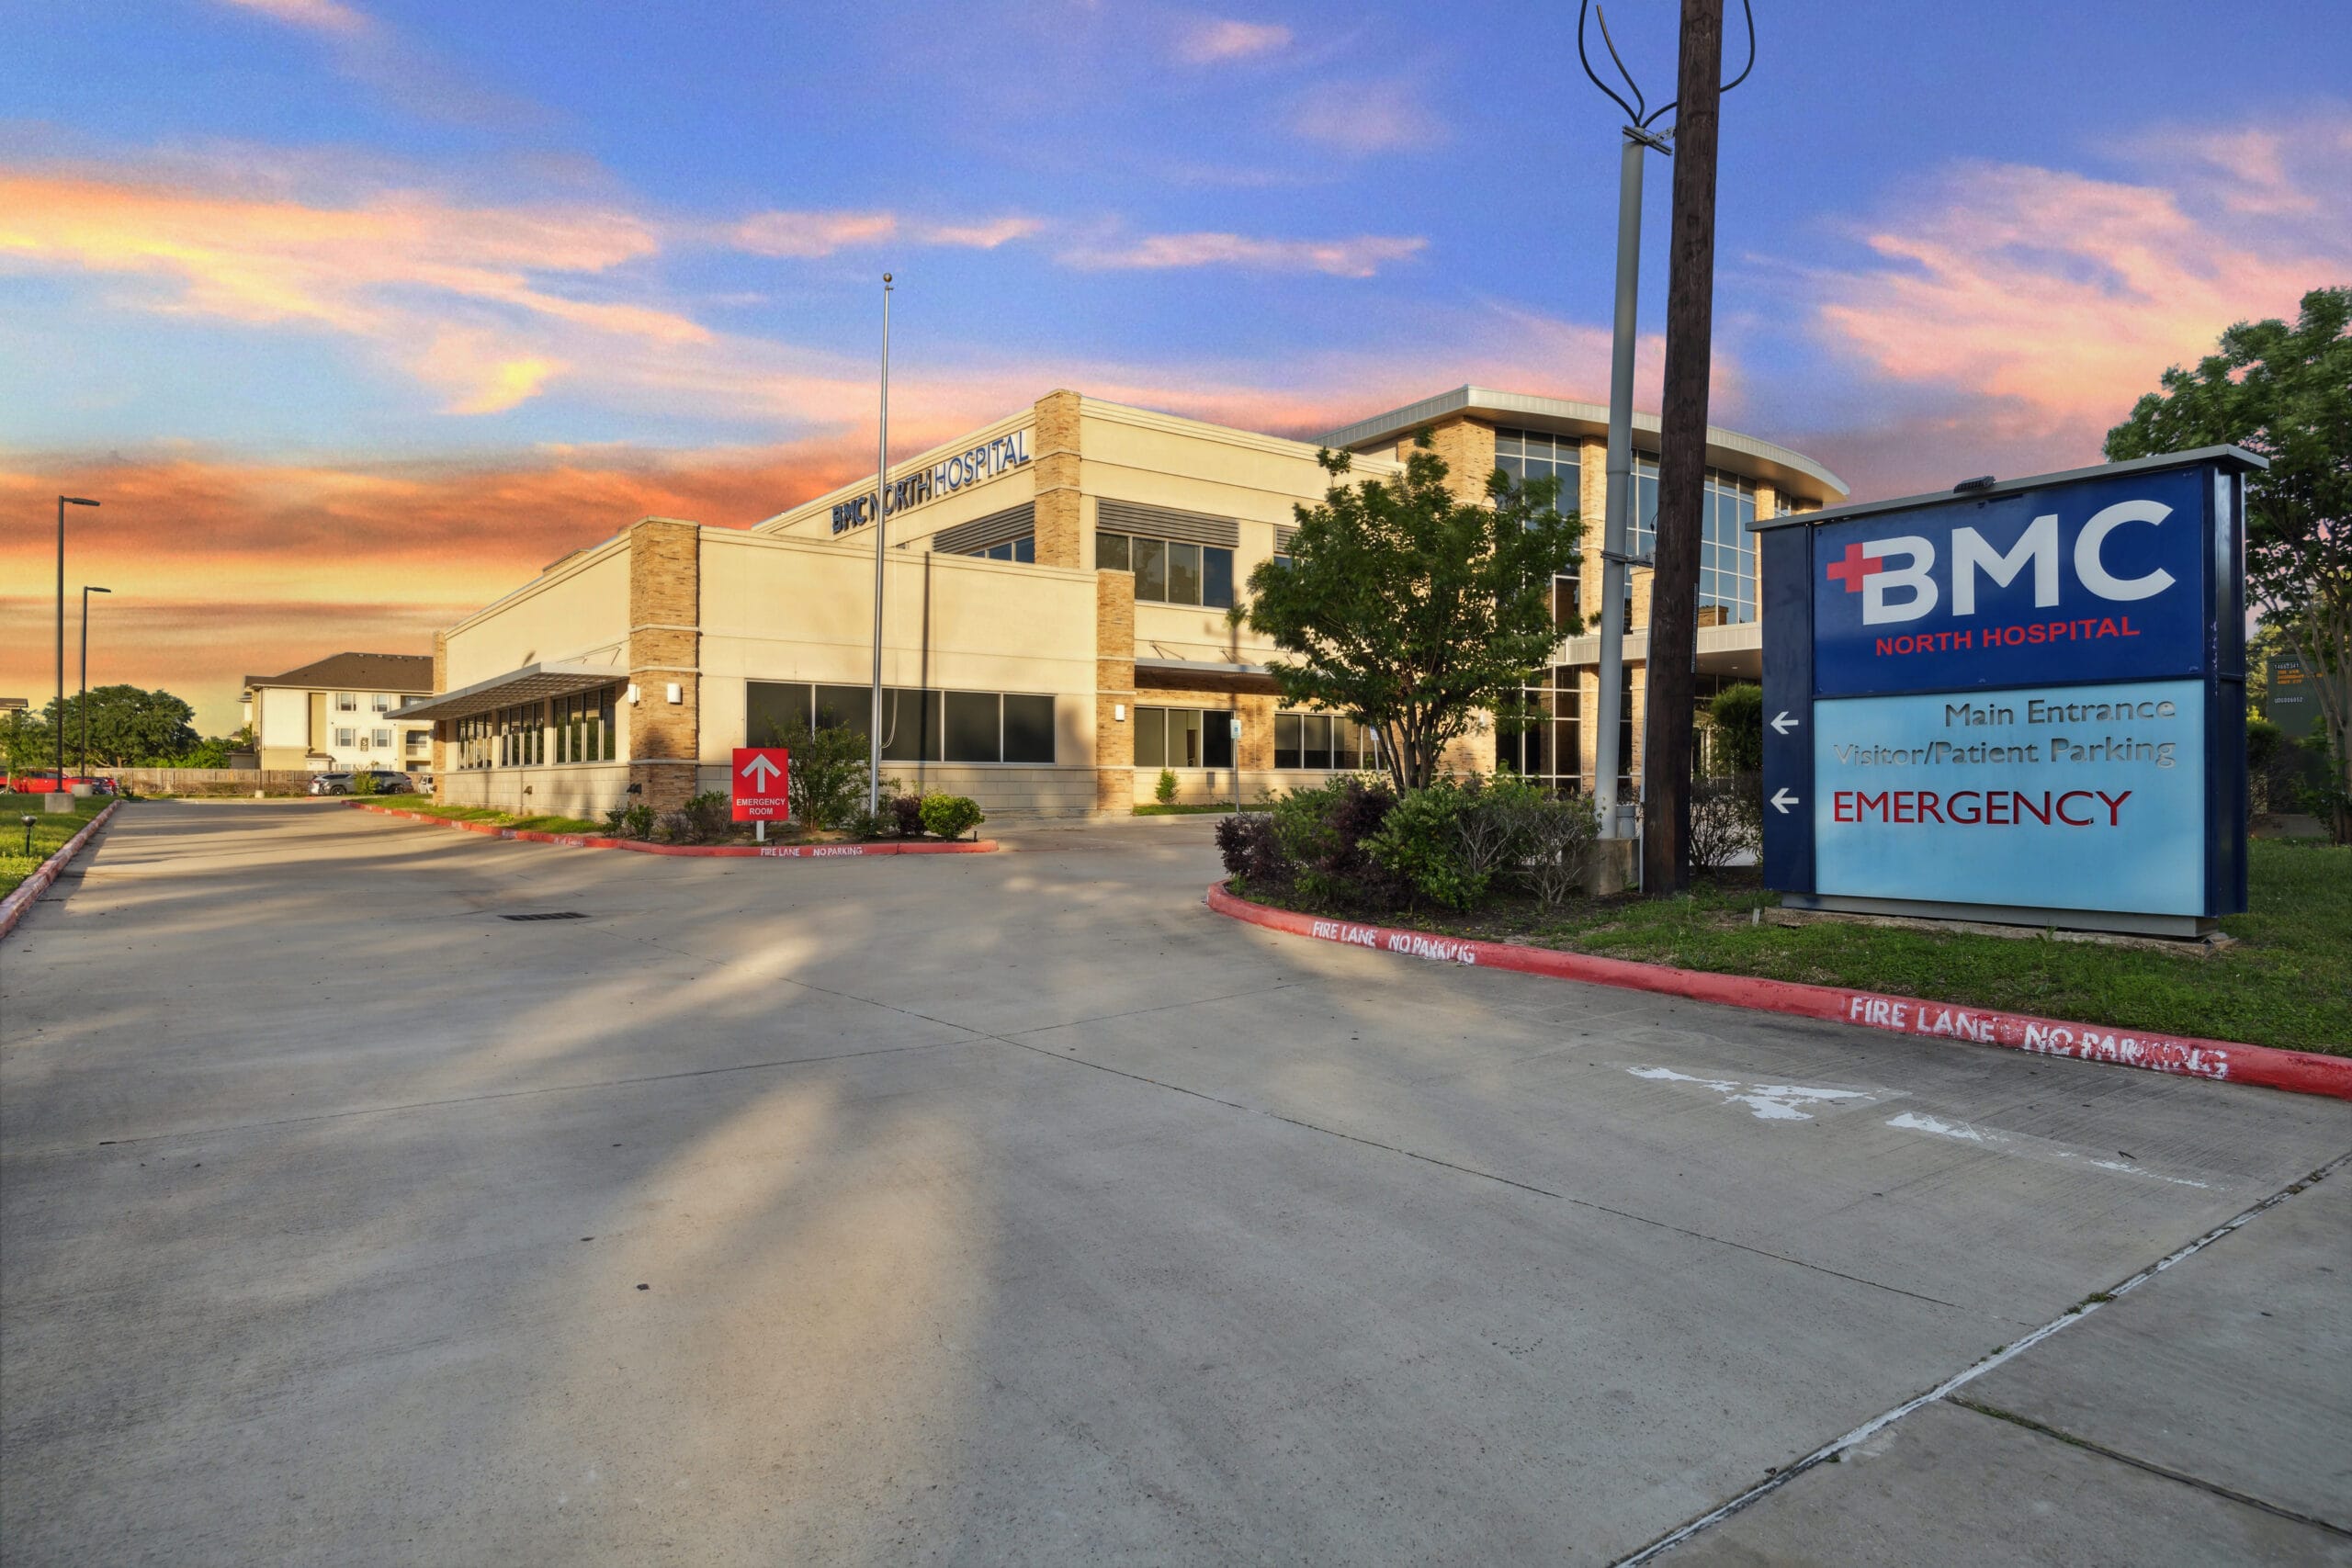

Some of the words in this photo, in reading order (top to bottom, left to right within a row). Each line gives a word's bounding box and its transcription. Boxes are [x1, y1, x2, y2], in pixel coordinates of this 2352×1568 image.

[831, 496, 867, 535] BMC
[868, 468, 933, 521] NORTH
[934, 430, 1030, 498] HOSPITAL
[1862, 500, 2177, 626] BMC
[1875, 630, 1973, 657] NORTH
[1983, 615, 2141, 649] HOSPITAL
[1945, 704, 2014, 728] Main
[2028, 699, 2177, 725] Entrance
[1834, 741, 2039, 766] Visitor/Patient
[2051, 737, 2177, 769] Parking
[736, 798, 786, 807] EMERGENCY
[749, 807, 774, 816] ROOM
[1834, 790, 2132, 826] EMERGENCY
[761, 848, 777, 856] FIRE
[778, 848, 800, 856] LANE
[813, 848, 827, 856] NO
[828, 847, 863, 855] PARKING
[1313, 920, 1338, 939] FIRE
[1341, 925, 1377, 947] LANE
[1388, 933, 1410, 953] NO
[1849, 997, 1906, 1027] FIRE
[1917, 1007, 1996, 1042] LANE
[2024, 1025, 2073, 1054] NO
